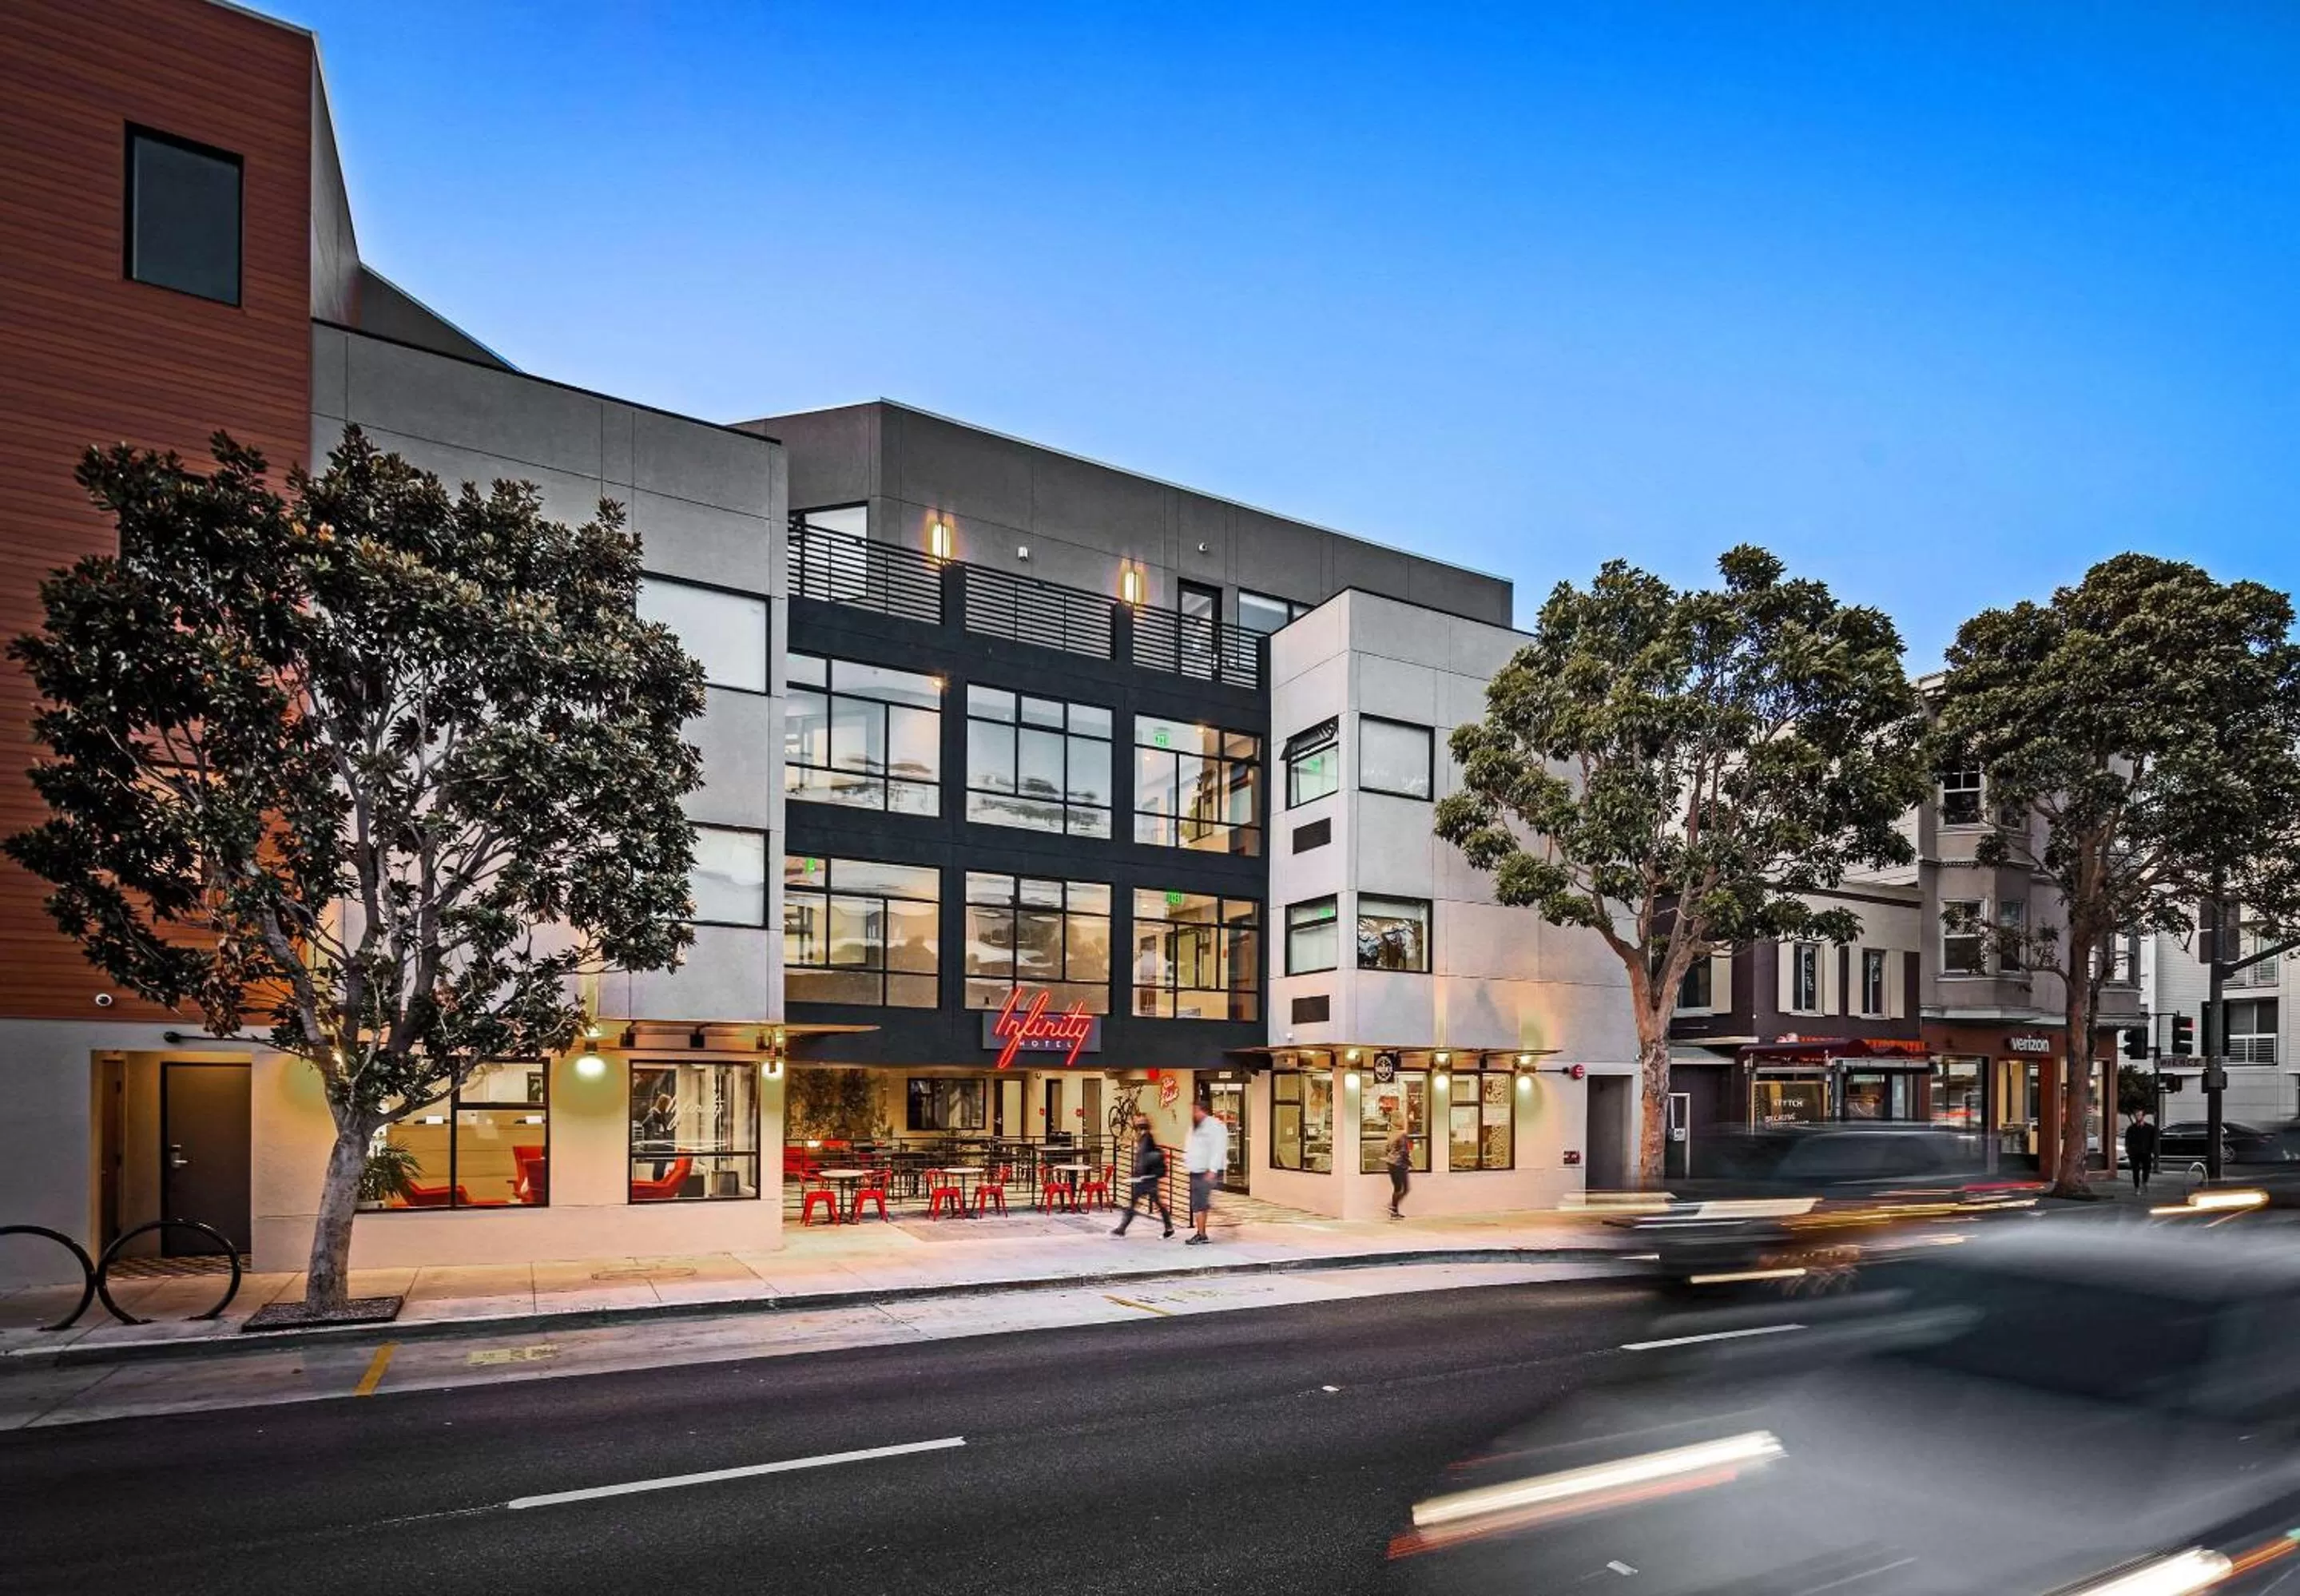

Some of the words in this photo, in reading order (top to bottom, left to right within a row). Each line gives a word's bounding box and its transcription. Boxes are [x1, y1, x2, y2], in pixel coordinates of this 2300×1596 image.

[995, 987, 1093, 1069] Infinity
[1019, 1040, 1073, 1049] HOTEL
[2011, 1034, 2049, 1052] verizon
